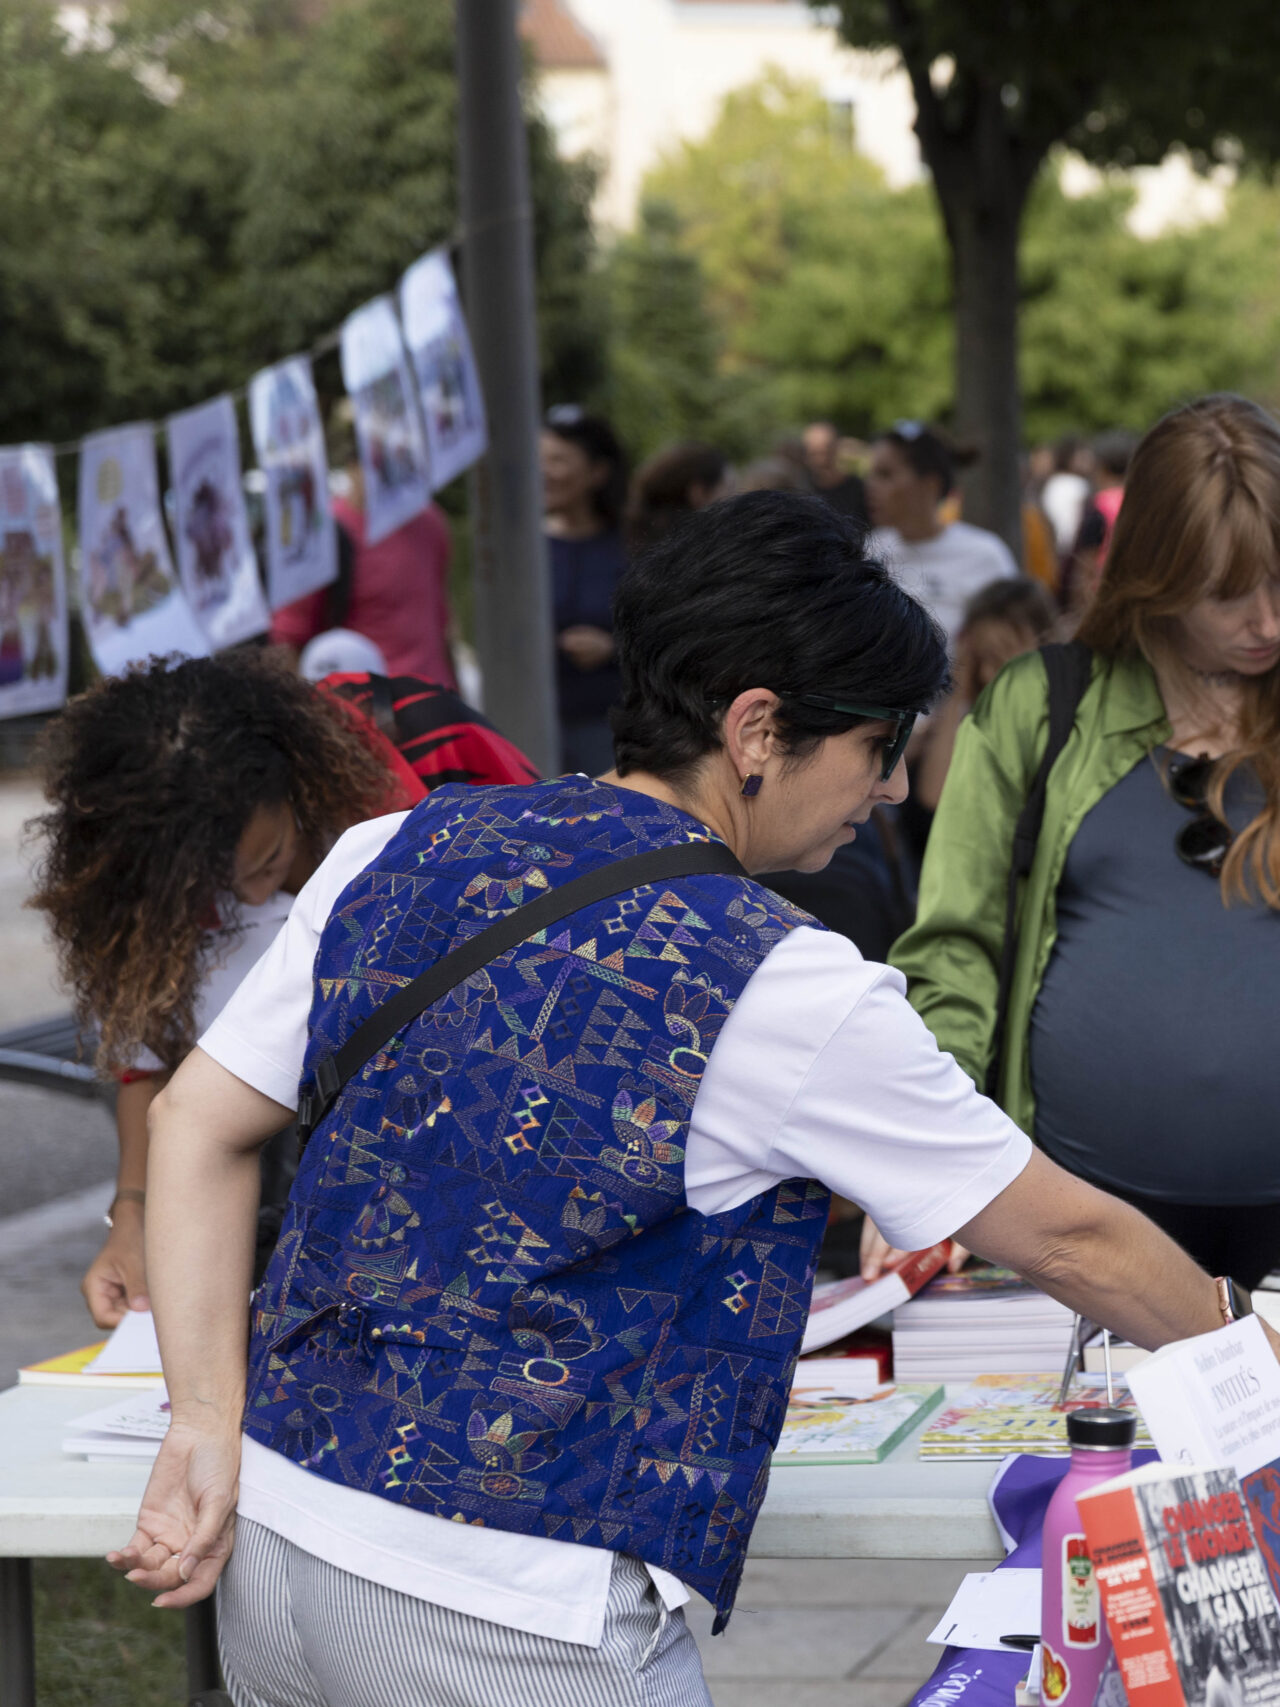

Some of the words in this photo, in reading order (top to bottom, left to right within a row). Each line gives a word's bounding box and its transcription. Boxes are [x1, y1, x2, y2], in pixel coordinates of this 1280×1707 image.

[1208, 1365, 1264, 1412] AMITIÉS
[1160, 1489, 1245, 1536] CHANGER
[1162, 1535, 1187, 1569] LE
[1185, 1518, 1255, 1563] MONDE
[1174, 1553, 1268, 1605] CHANGER
[1212, 1591, 1244, 1628] SA
[1238, 1582, 1276, 1621] VIE
